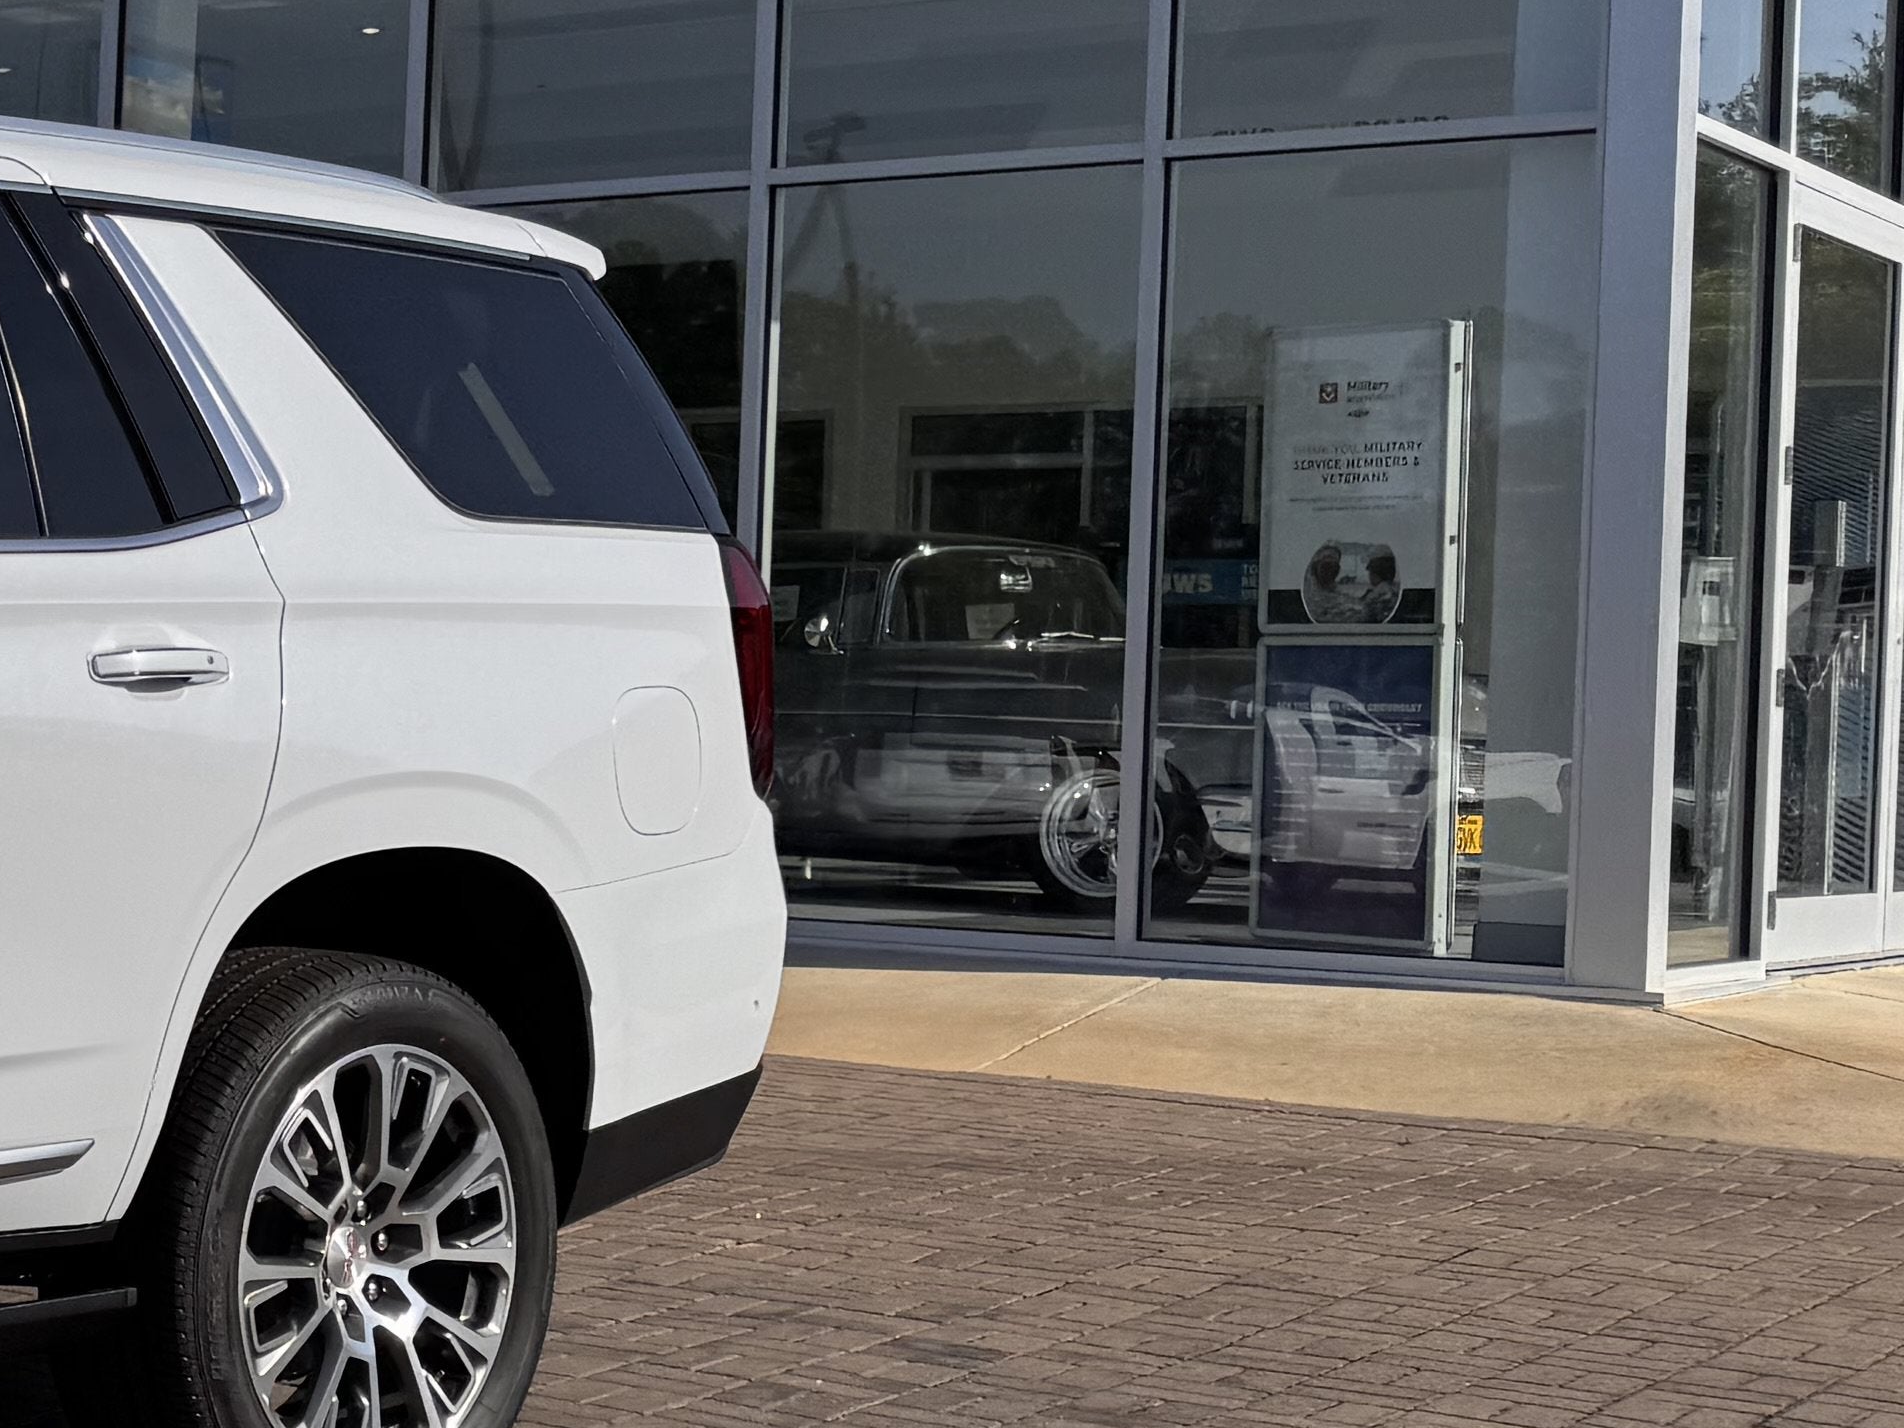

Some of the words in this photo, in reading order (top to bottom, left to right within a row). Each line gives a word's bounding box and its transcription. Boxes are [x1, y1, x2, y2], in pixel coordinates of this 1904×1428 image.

[1364, 440, 1424, 454] MILITARY
[1293, 457, 1342, 471] SERVICE
[1345, 455, 1409, 470] MEMBERS
[1321, 472, 1390, 486] VETERANS
